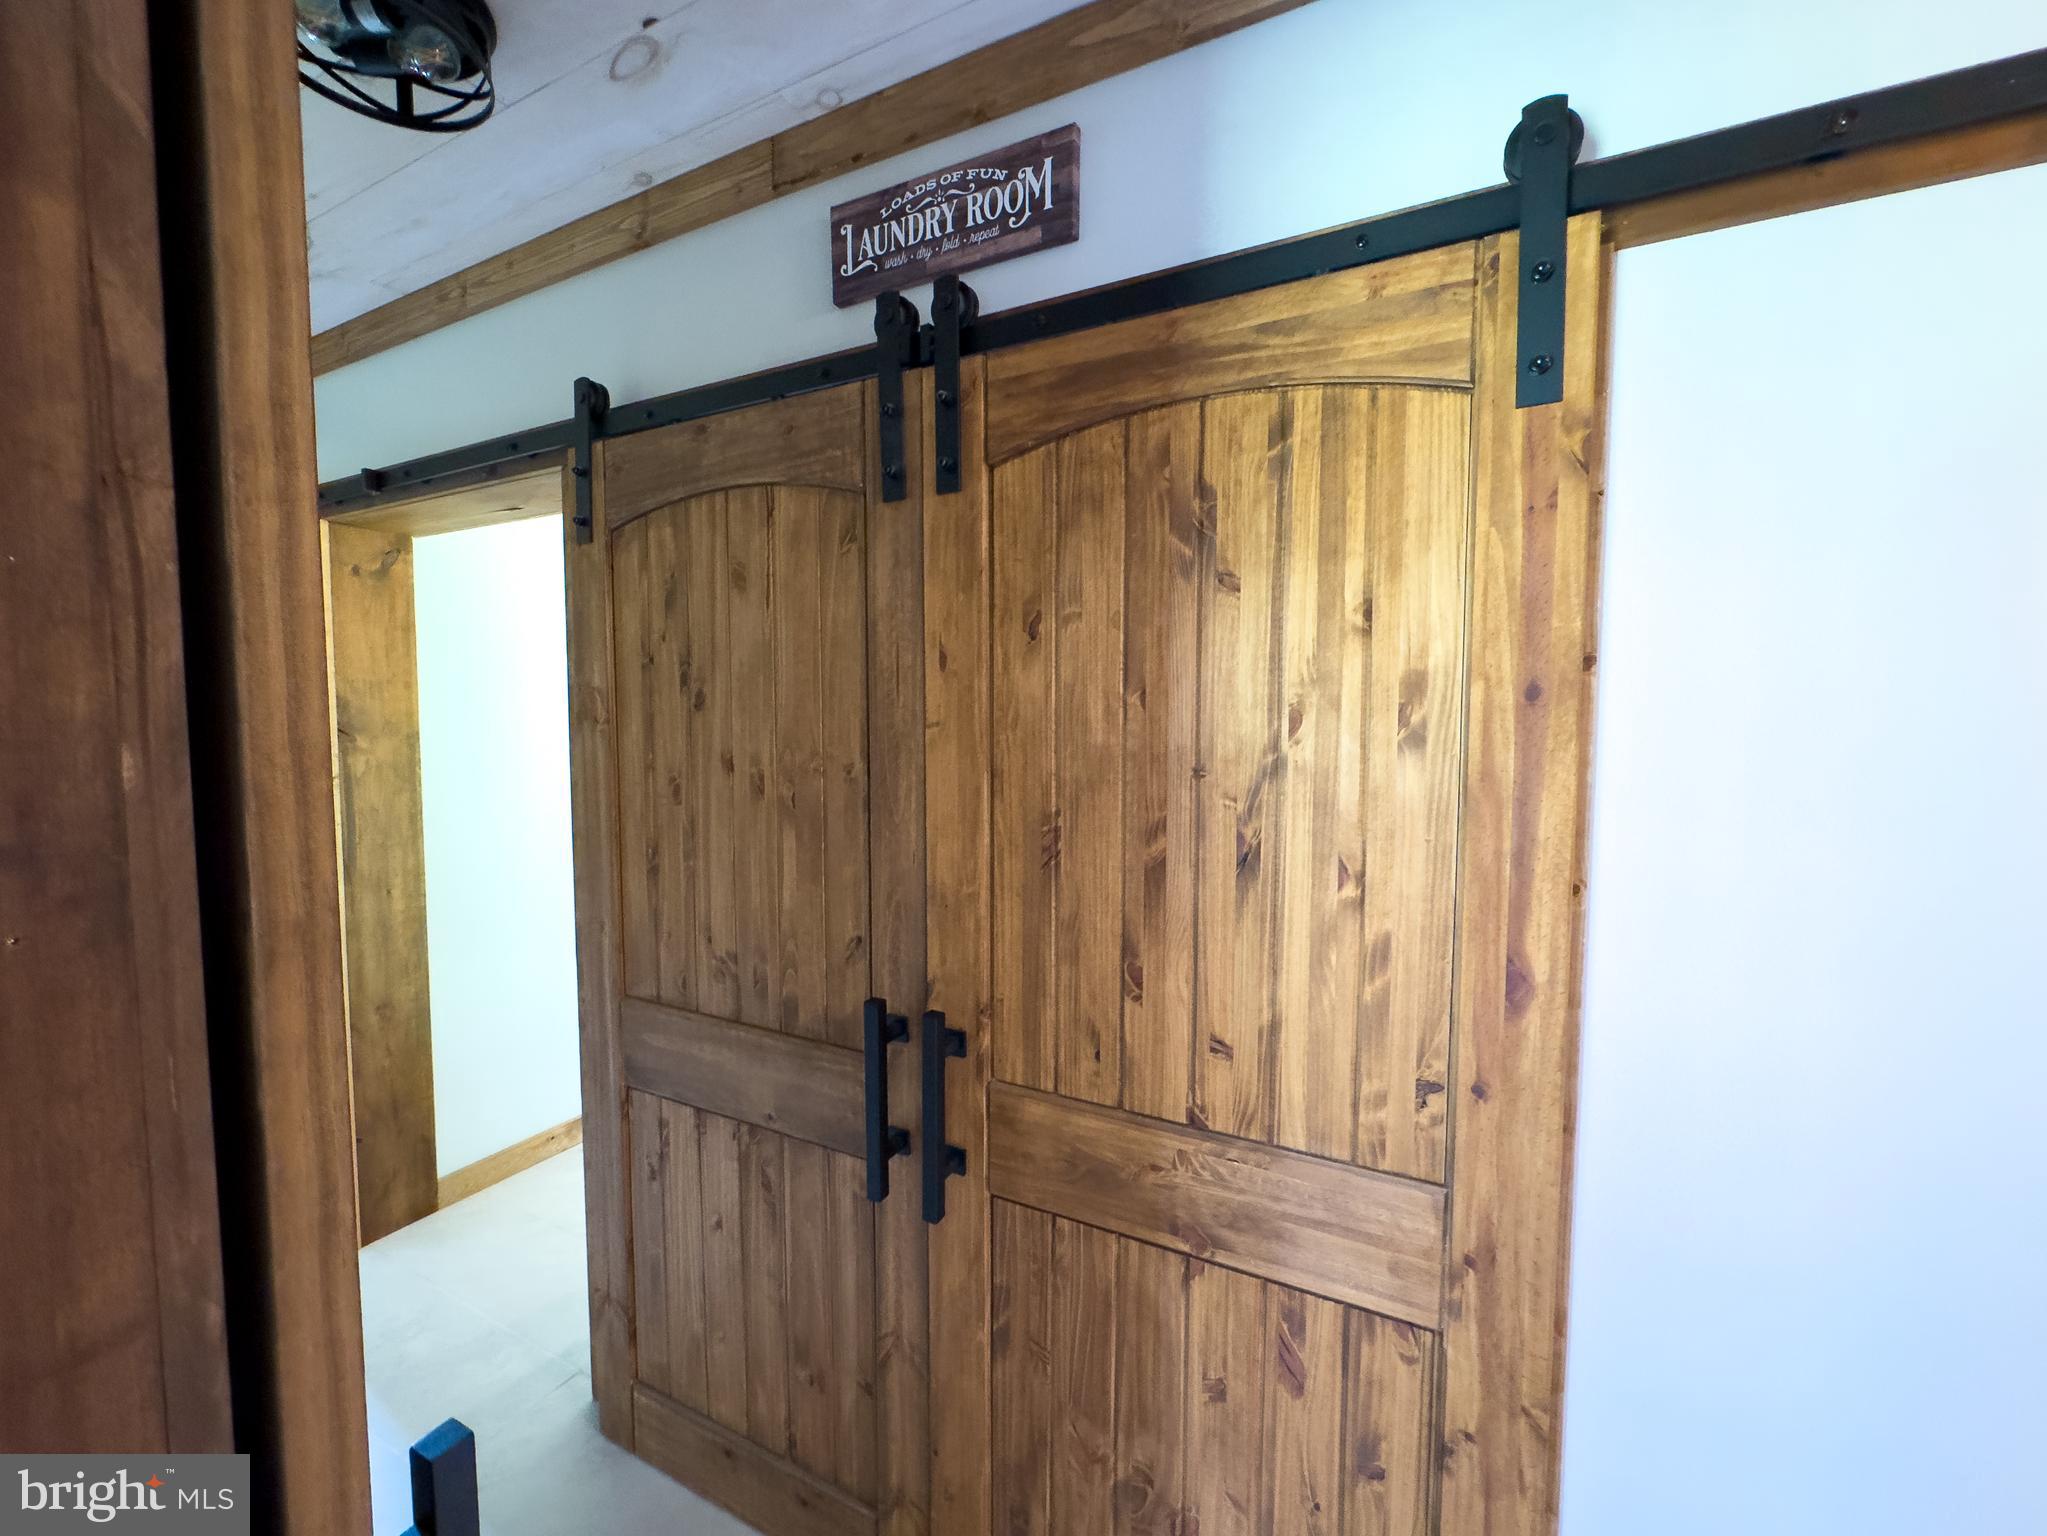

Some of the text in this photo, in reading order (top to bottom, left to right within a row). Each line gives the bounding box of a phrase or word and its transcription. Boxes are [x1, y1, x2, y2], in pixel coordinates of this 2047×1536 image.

[840, 156, 1054, 277] LAUNDRY ROOM
[880, 168, 1008, 219] LOADS OF FUN
[884, 224, 1000, 270] wash dry fold repeat
